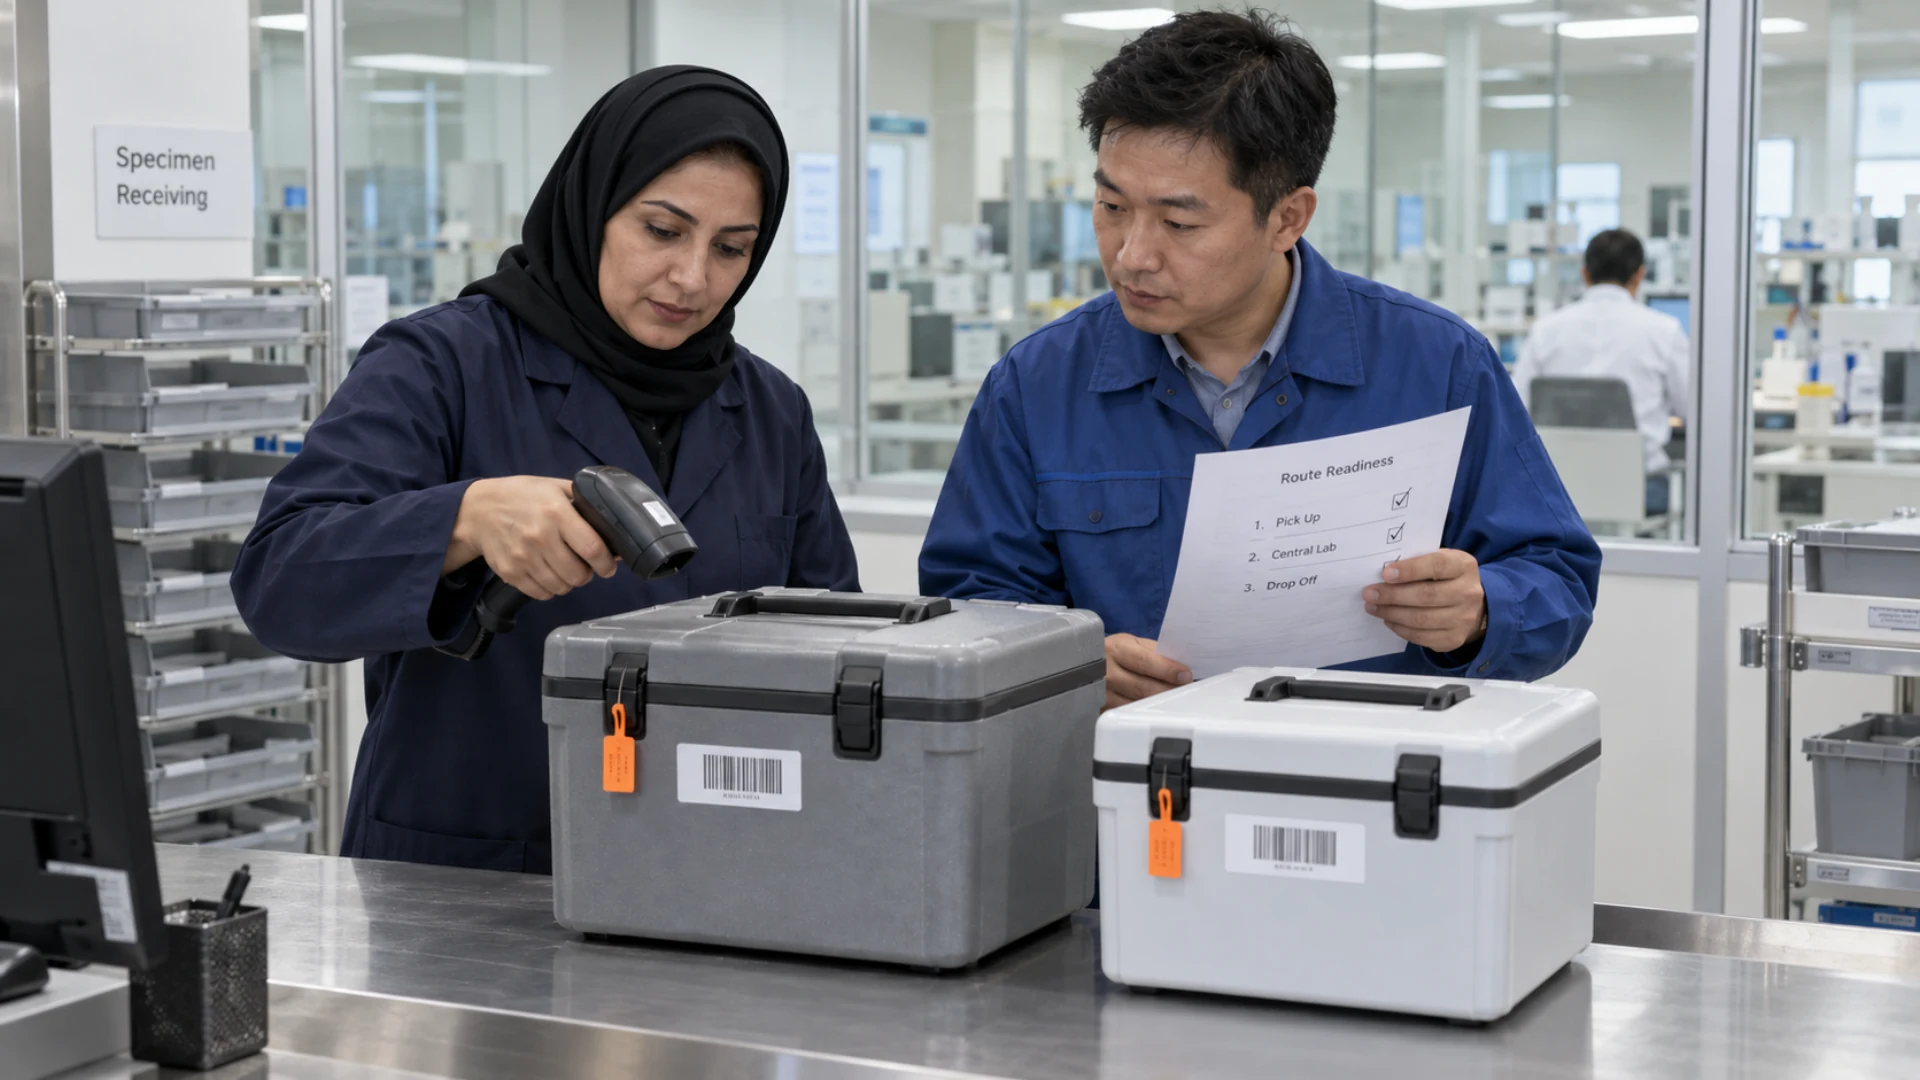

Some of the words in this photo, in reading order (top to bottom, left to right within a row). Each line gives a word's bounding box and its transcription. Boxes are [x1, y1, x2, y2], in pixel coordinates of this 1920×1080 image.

[116, 145, 215, 173] Specimen
[116, 183, 208, 212] Receiving
[1280, 470, 1322, 484] Route
[1326, 456, 1394, 477] Readiness
[1254, 520, 1264, 530] 1.
[1276, 515, 1300, 528] Pick
[1304, 513, 1321, 524] Up
[1248, 552, 1260, 562] 2.
[1271, 545, 1313, 560] Central
[1316, 542, 1337, 554] Lab
[1244, 583, 1255, 593] 3.
[1266, 580, 1296, 591] Drop
[1299, 574, 1318, 585] Off
